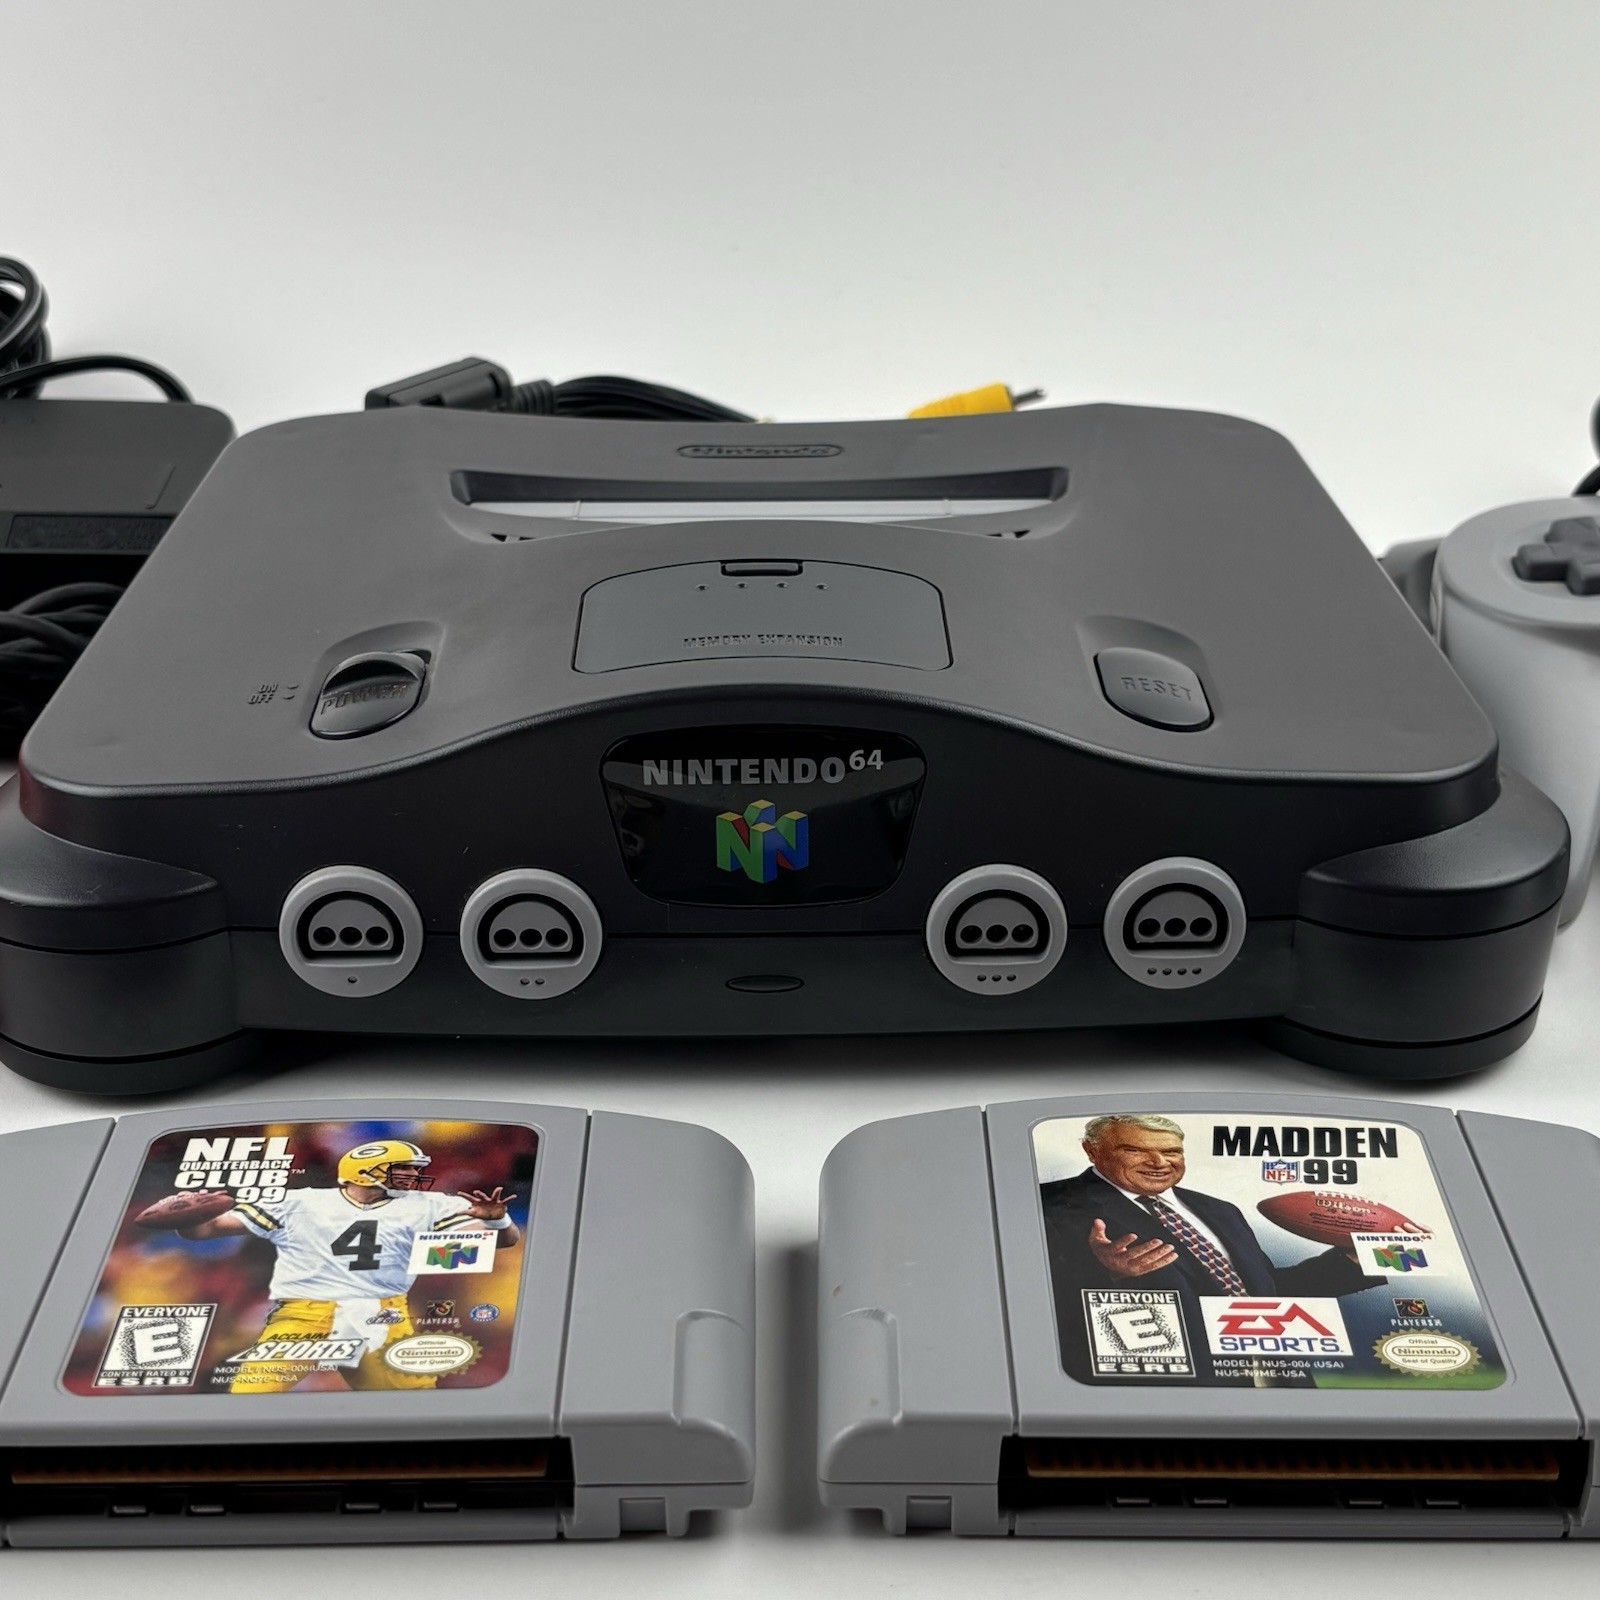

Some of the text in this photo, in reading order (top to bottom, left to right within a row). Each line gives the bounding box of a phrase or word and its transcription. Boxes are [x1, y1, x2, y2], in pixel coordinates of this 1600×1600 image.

[683, 634, 843, 647] MEMORY EXPANSION
[257, 683, 279, 694] ON
[1121, 677, 1191, 701] RESET
[247, 693, 275, 705] OFF
[1212, 1126, 1399, 1158] MADDEN
[182, 1137, 295, 1162] NFL
[179, 1160, 293, 1171] QUARTERBACK
[1303, 1159, 1358, 1184] 99
[174, 1169, 290, 1188] CLUB
[1265, 1169, 1297, 1181] NFL
[235, 1186, 287, 1204] 99
[1315, 1198, 1372, 1214] Wilson
[330, 1220, 383, 1272] 4
[1087, 1292, 1176, 1304] EVERYONE
[122, 1306, 211, 1318] EVERYONE
[1217, 1302, 1336, 1337] EA
[265, 1331, 329, 1341] ACCLAIM
[1107, 1309, 1171, 1351] E
[132, 1323, 183, 1365] E
[248, 1338, 364, 1361] SPORTS
[1219, 1336, 1341, 1353] SPORTS
[401, 1348, 459, 1357] Nintendo
[1397, 1347, 1456, 1356] Nintendo
[1096, 1356, 1140, 1364] CONTENT
[1141, 1356, 1173, 1364] RATED
[1429, 1357, 1457, 1365] Quality
[100, 1368, 192, 1378] CONTENT RATED BY
[1098, 1363, 1190, 1373] ESRB
[97, 1376, 190, 1386] ESRB
